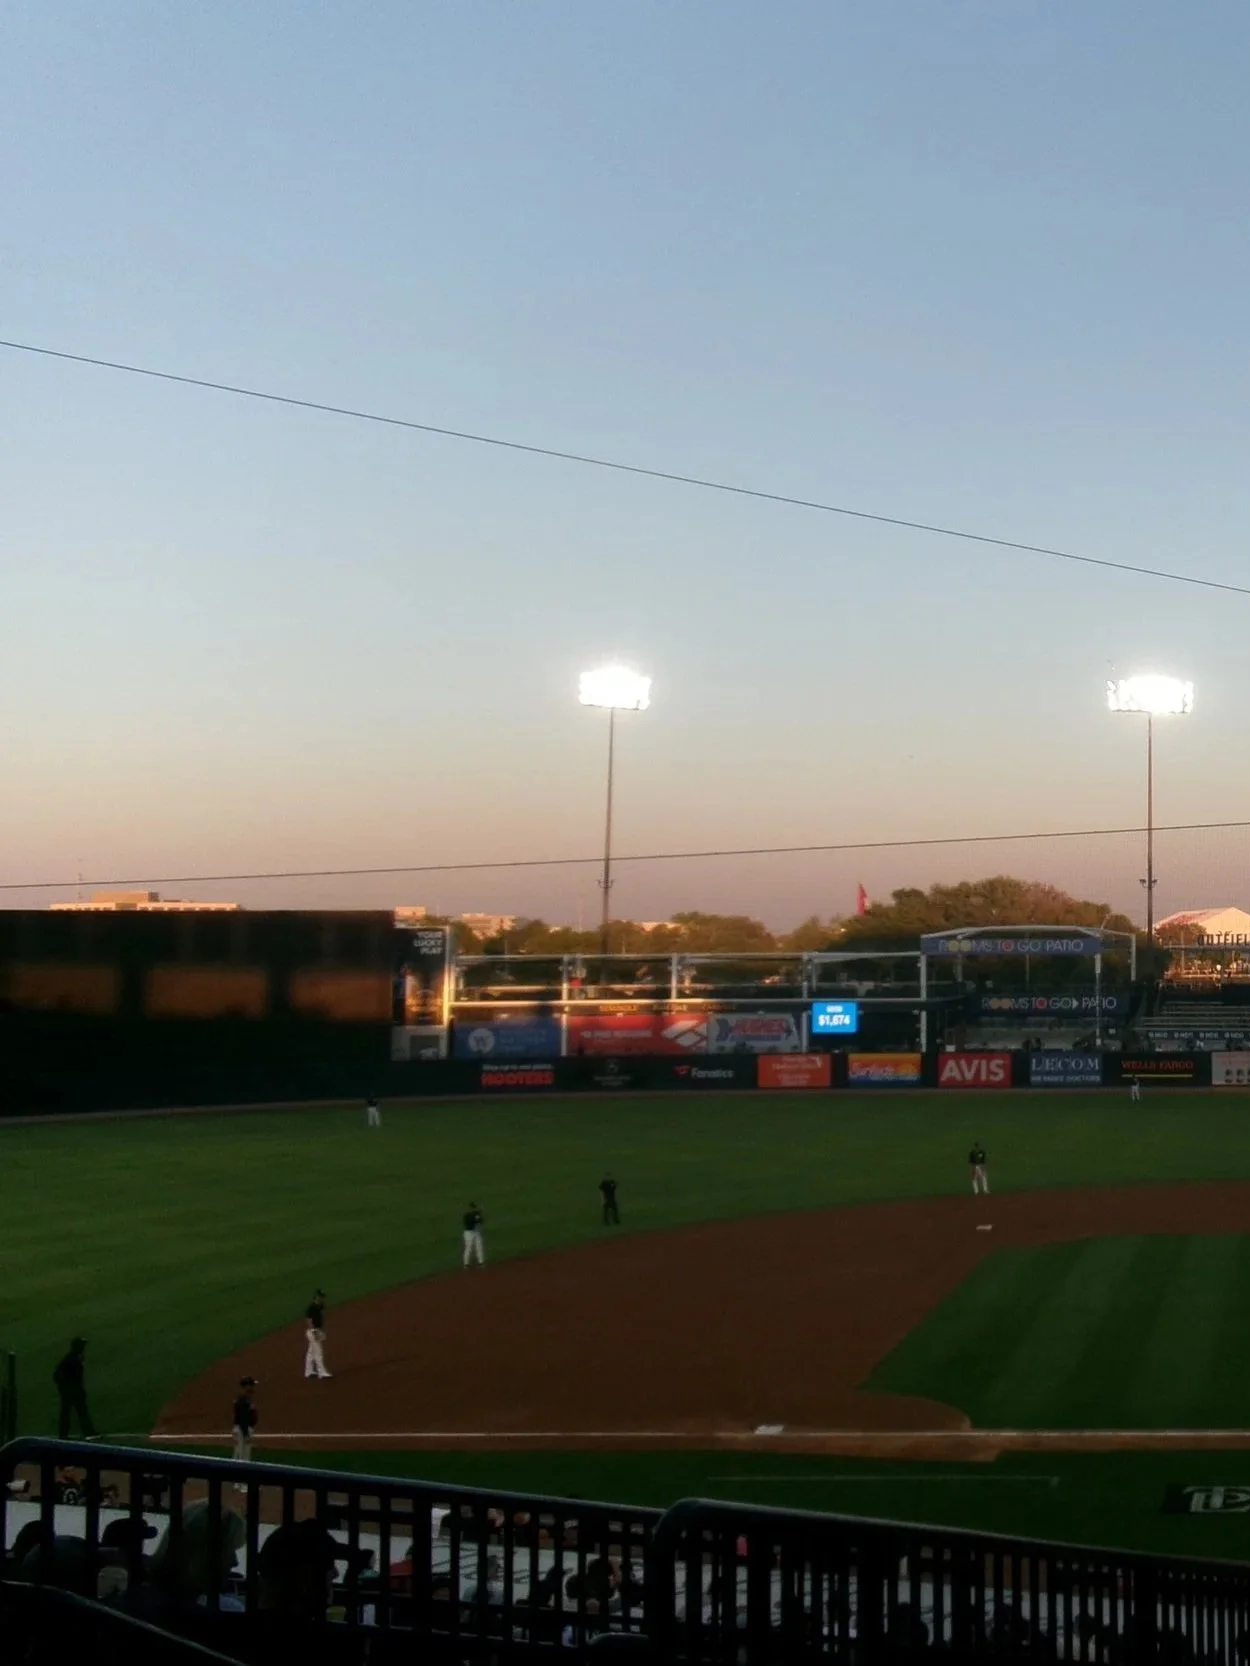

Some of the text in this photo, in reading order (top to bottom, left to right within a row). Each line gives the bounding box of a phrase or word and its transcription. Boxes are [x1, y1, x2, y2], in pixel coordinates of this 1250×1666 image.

[938, 939, 1083, 952] ROOMS TO GO PATIO
[1031, 997, 1048, 1010] TO
[1050, 997, 1071, 1009] GO
[1082, 996, 1117, 1009] PATIO
[939, 1059, 1005, 1082] AVIS
[1031, 1057, 1100, 1071] LECOM
[1121, 1060, 1194, 1071] WELLS FARGO
[691, 1067, 735, 1079] Fanatics
